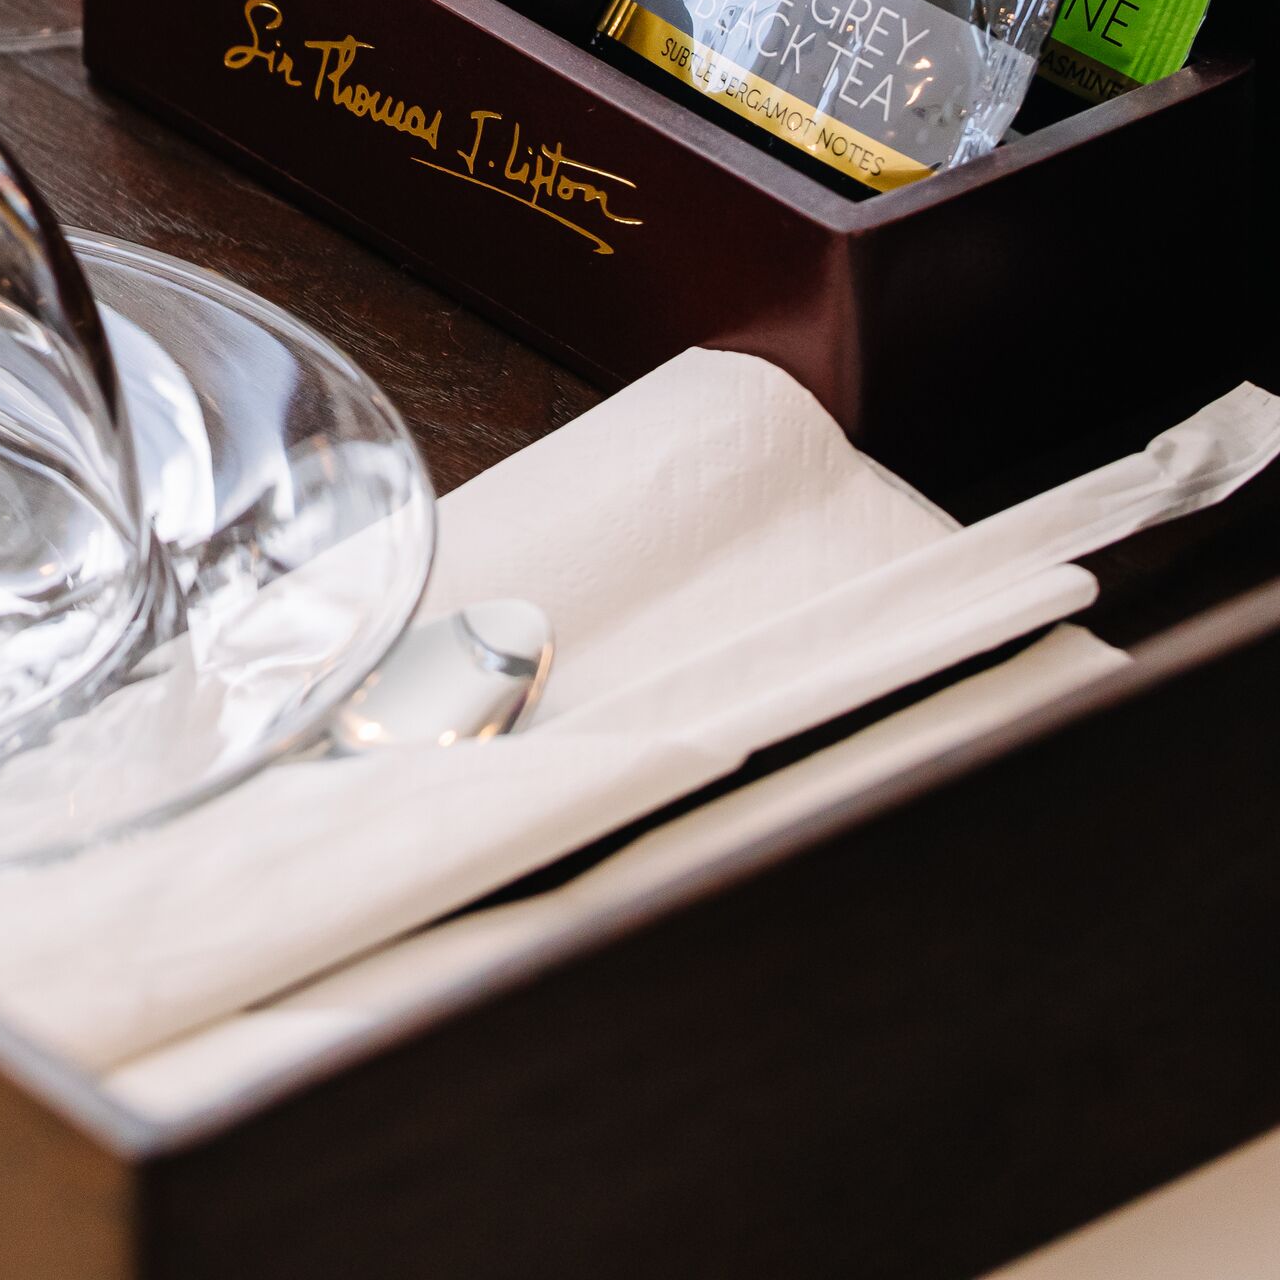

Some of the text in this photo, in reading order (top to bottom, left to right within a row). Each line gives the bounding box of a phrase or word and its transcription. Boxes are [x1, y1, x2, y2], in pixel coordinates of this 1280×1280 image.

[661, 37, 887, 178] SUBTLE BERGAMOT NOTES
[822, 40, 895, 122] TEA
[1038, 48, 1125, 96] ASMINE
[303, 34, 443, 151] Thomas
[504, 122, 645, 227] Lipton
